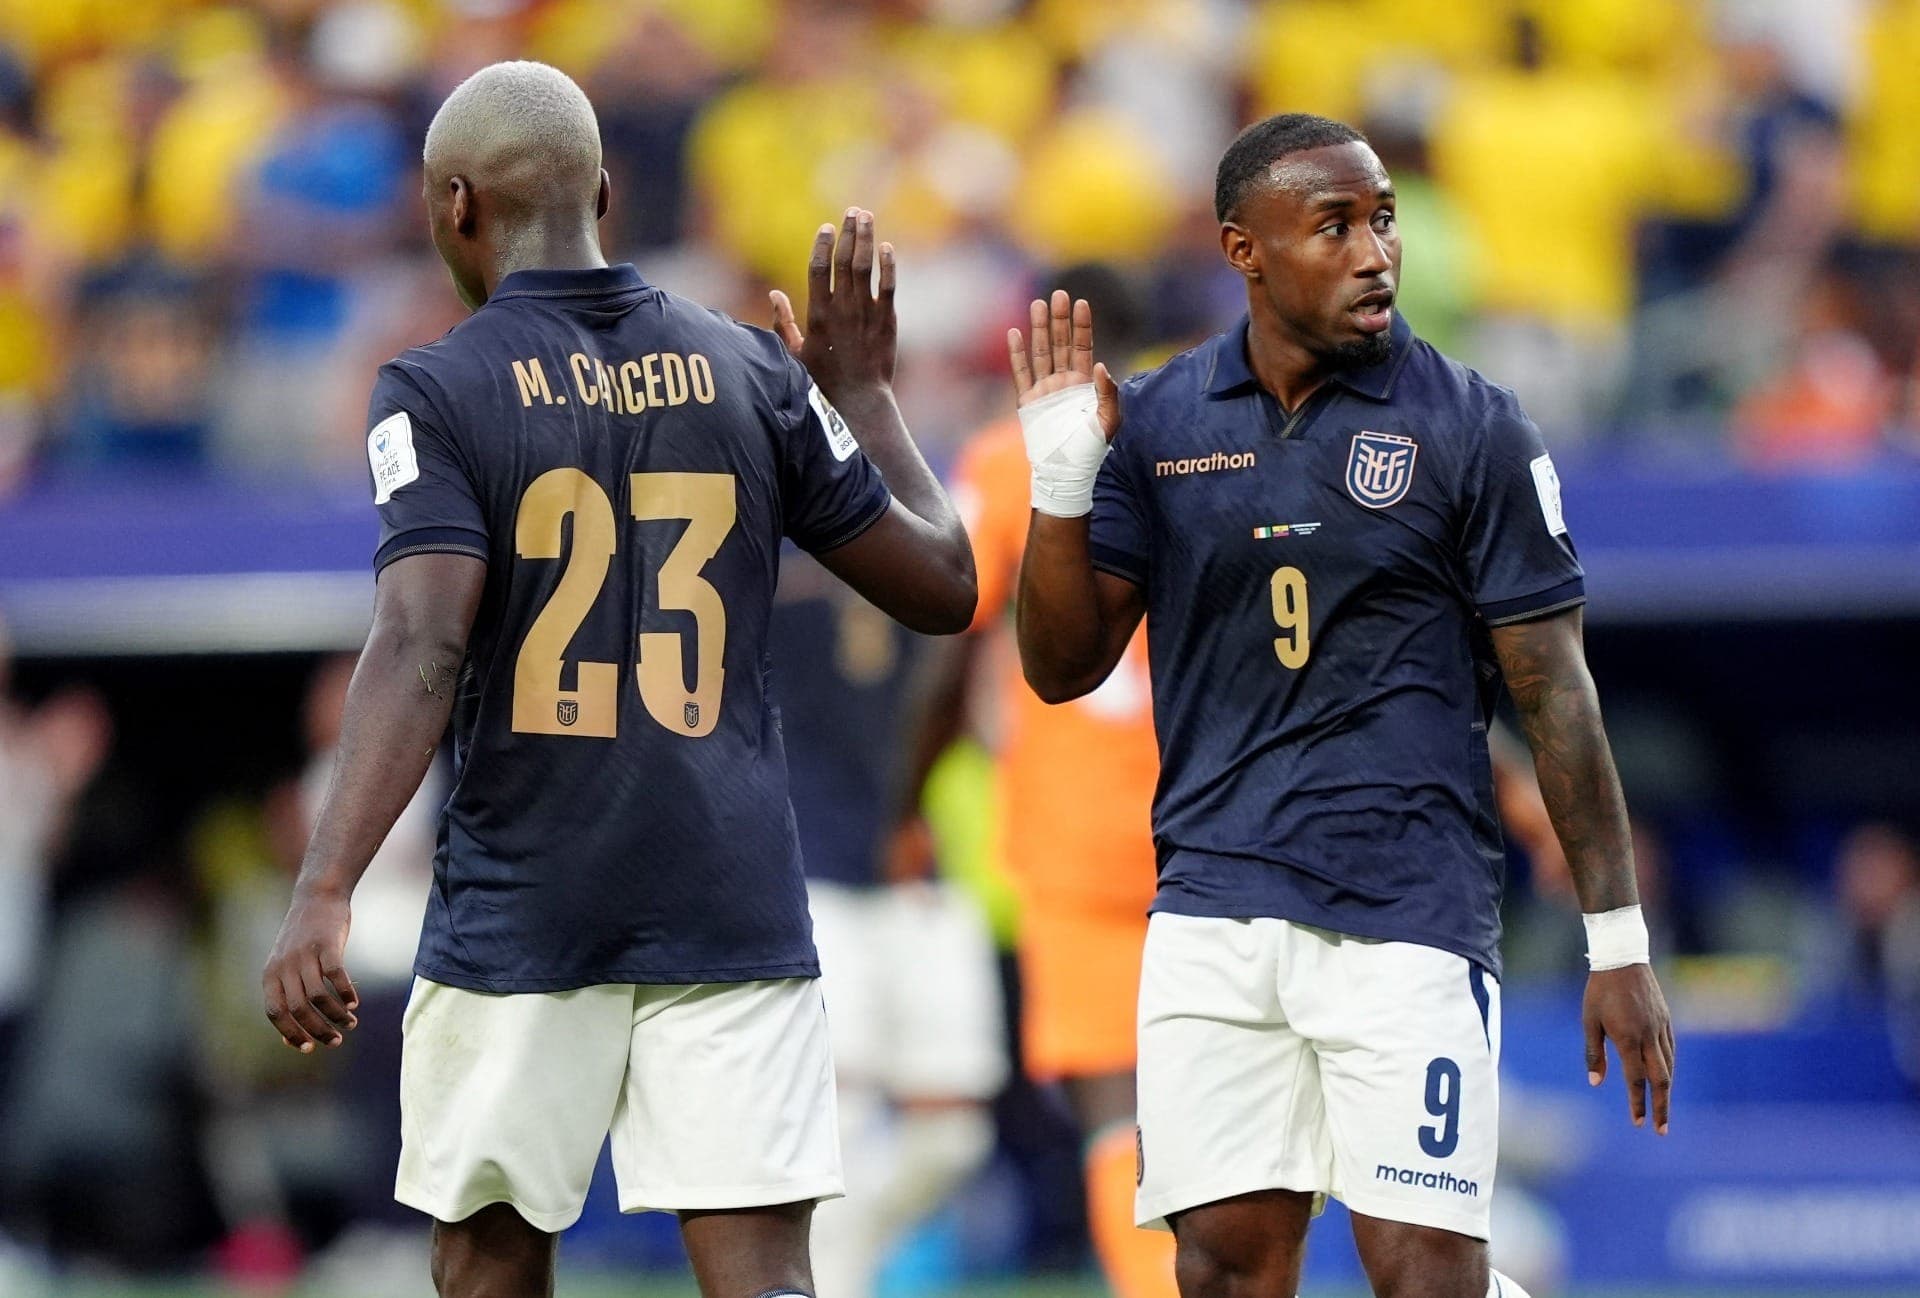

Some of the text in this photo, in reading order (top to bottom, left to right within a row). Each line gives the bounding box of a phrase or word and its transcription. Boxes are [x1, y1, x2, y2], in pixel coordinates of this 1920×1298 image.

[511, 352, 716, 415] M. CAICEDO
[840, 436, 854, 452] 202
[1156, 451, 1256, 477] marathon
[511, 466, 737, 739] 23
[1270, 565, 1311, 671] 9
[1417, 1056, 1462, 1159] 9
[1375, 1164, 1479, 1198] marathon
